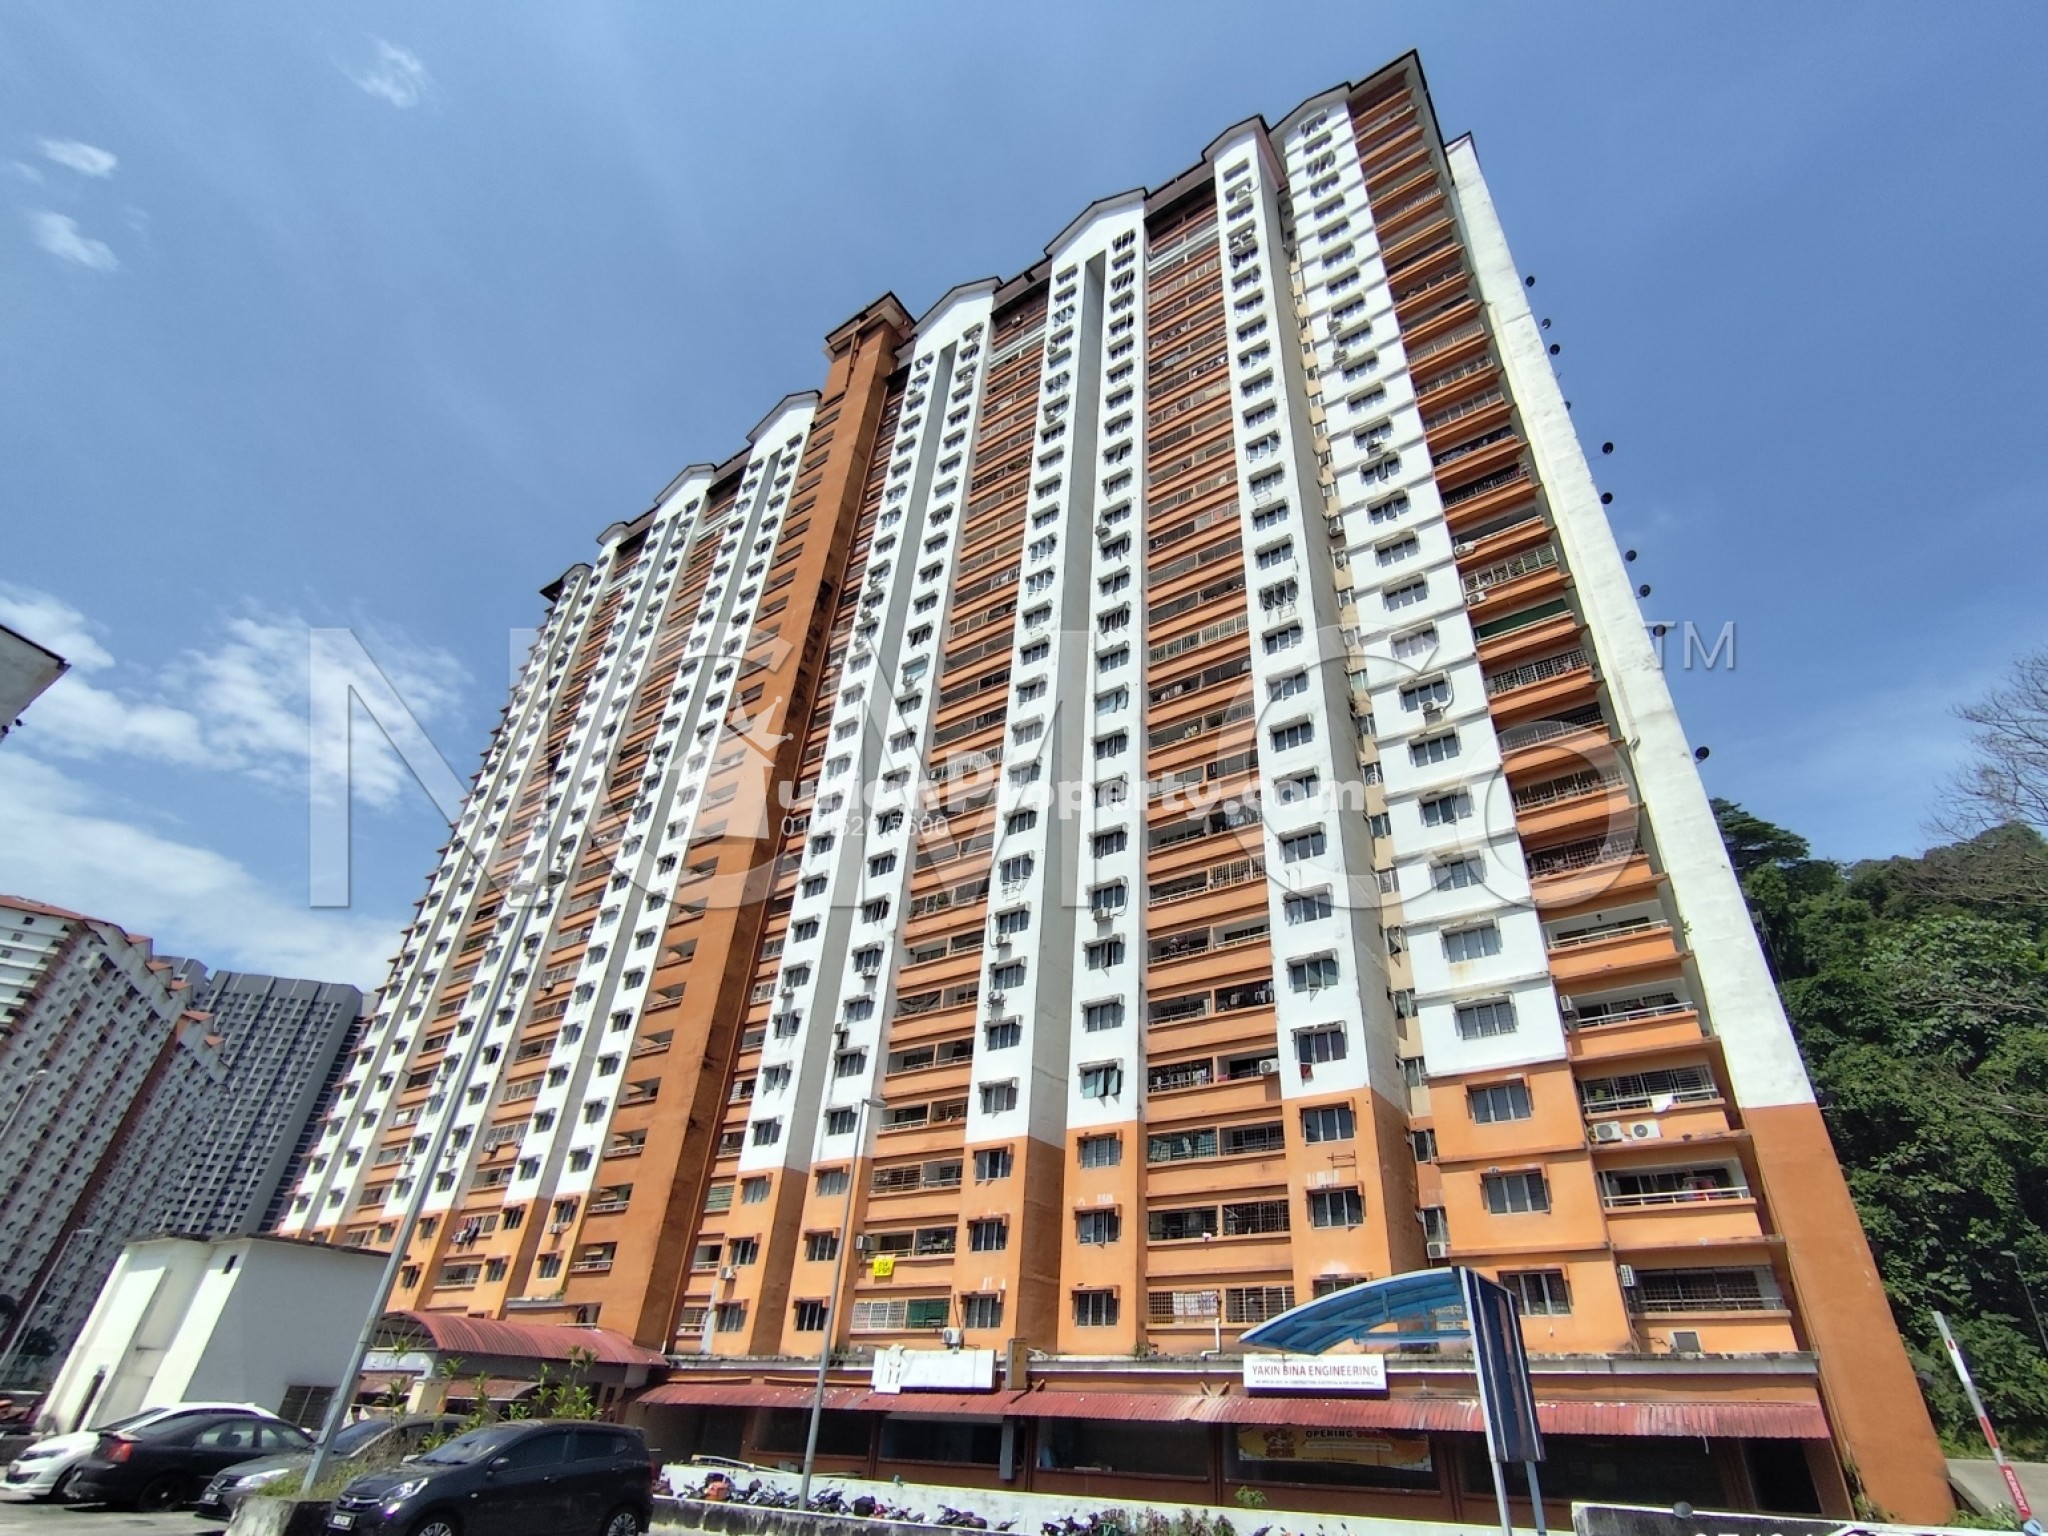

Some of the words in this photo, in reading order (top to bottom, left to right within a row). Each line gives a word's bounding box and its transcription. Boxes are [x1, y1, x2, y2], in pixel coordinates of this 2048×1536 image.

[1252, 1365, 1280, 1376] YAKIN
[1283, 1365, 1307, 1376] BINA
[1309, 1365, 1379, 1377] ENGINEERING
[1305, 1429, 1354, 1438] OPENING
